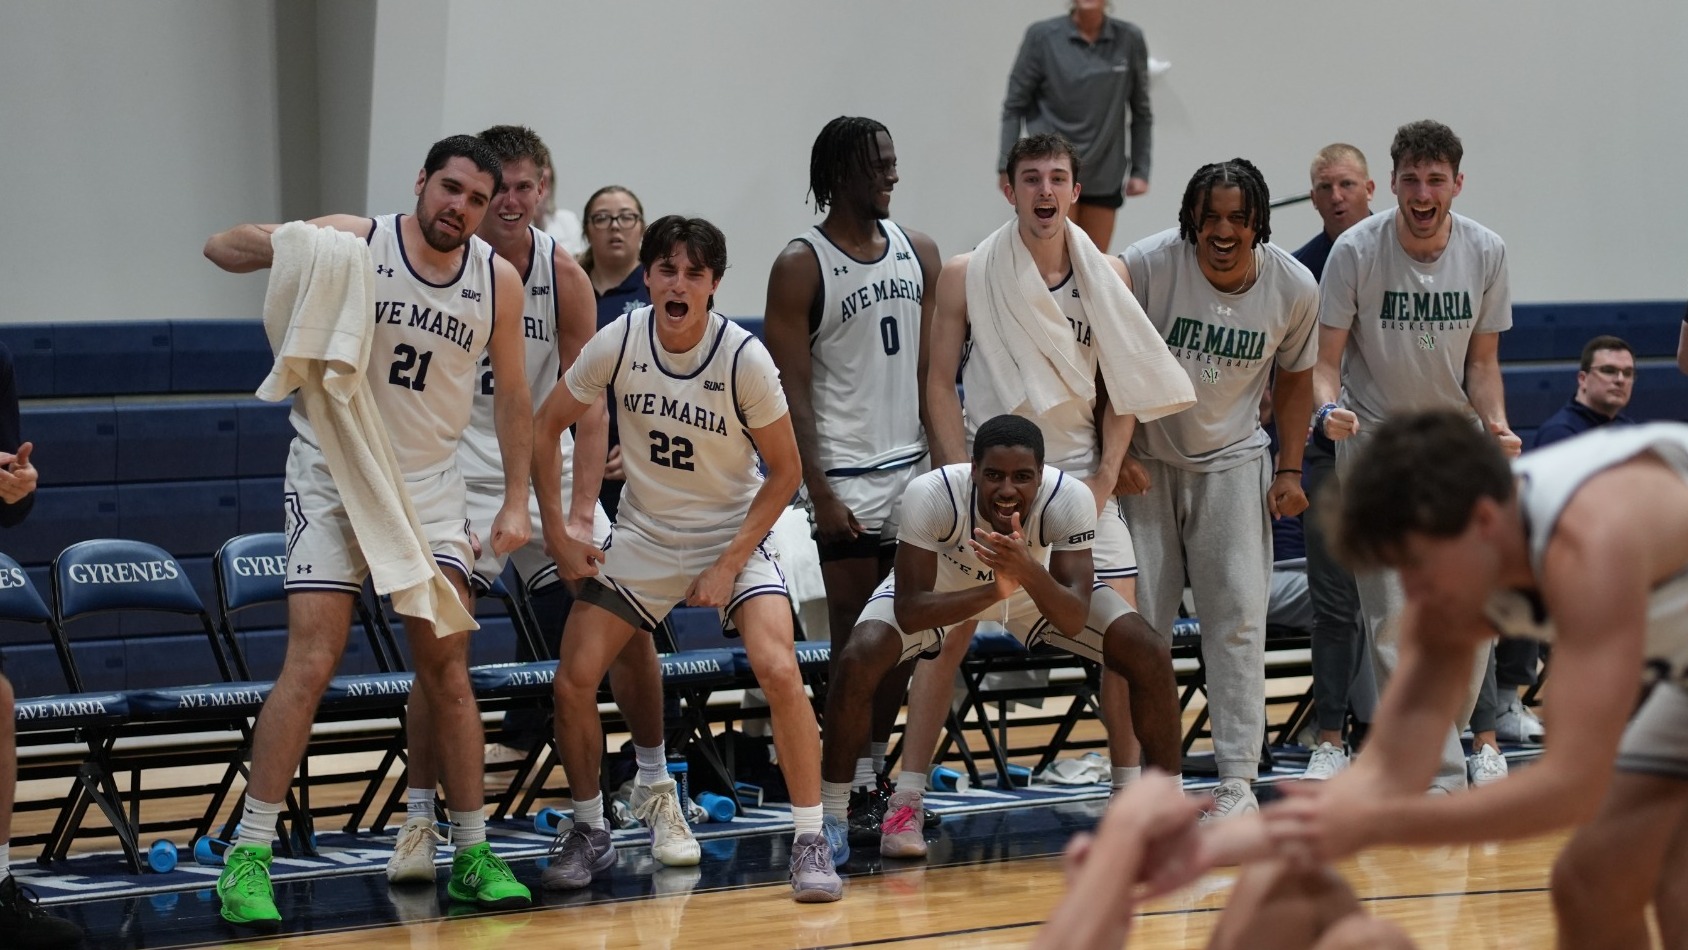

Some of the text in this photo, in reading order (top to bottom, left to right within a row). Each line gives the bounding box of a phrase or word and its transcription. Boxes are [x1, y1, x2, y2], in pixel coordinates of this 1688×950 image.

[841, 277, 923, 323] AVE MARIA
[1380, 290, 1473, 321] AVE MARIA
[408, 304, 474, 353] MARIA
[880, 315, 900, 356] 0
[1165, 316, 1266, 360] AVE MARIA
[1381, 320, 1471, 331] BASKETBALL
[388, 342, 433, 392] 21
[1167, 346, 1258, 369] ASKETBAL
[623, 393, 728, 436] AVE MARIA
[648, 428, 695, 472] 22
[68, 559, 179, 584] GYRENES
[677, 659, 720, 675] MARIA
[798, 648, 831, 664] MAR
[178, 690, 264, 709] AVE MARIA
[346, 682, 374, 697] AVE
[17, 700, 107, 721] AVE MARIA
